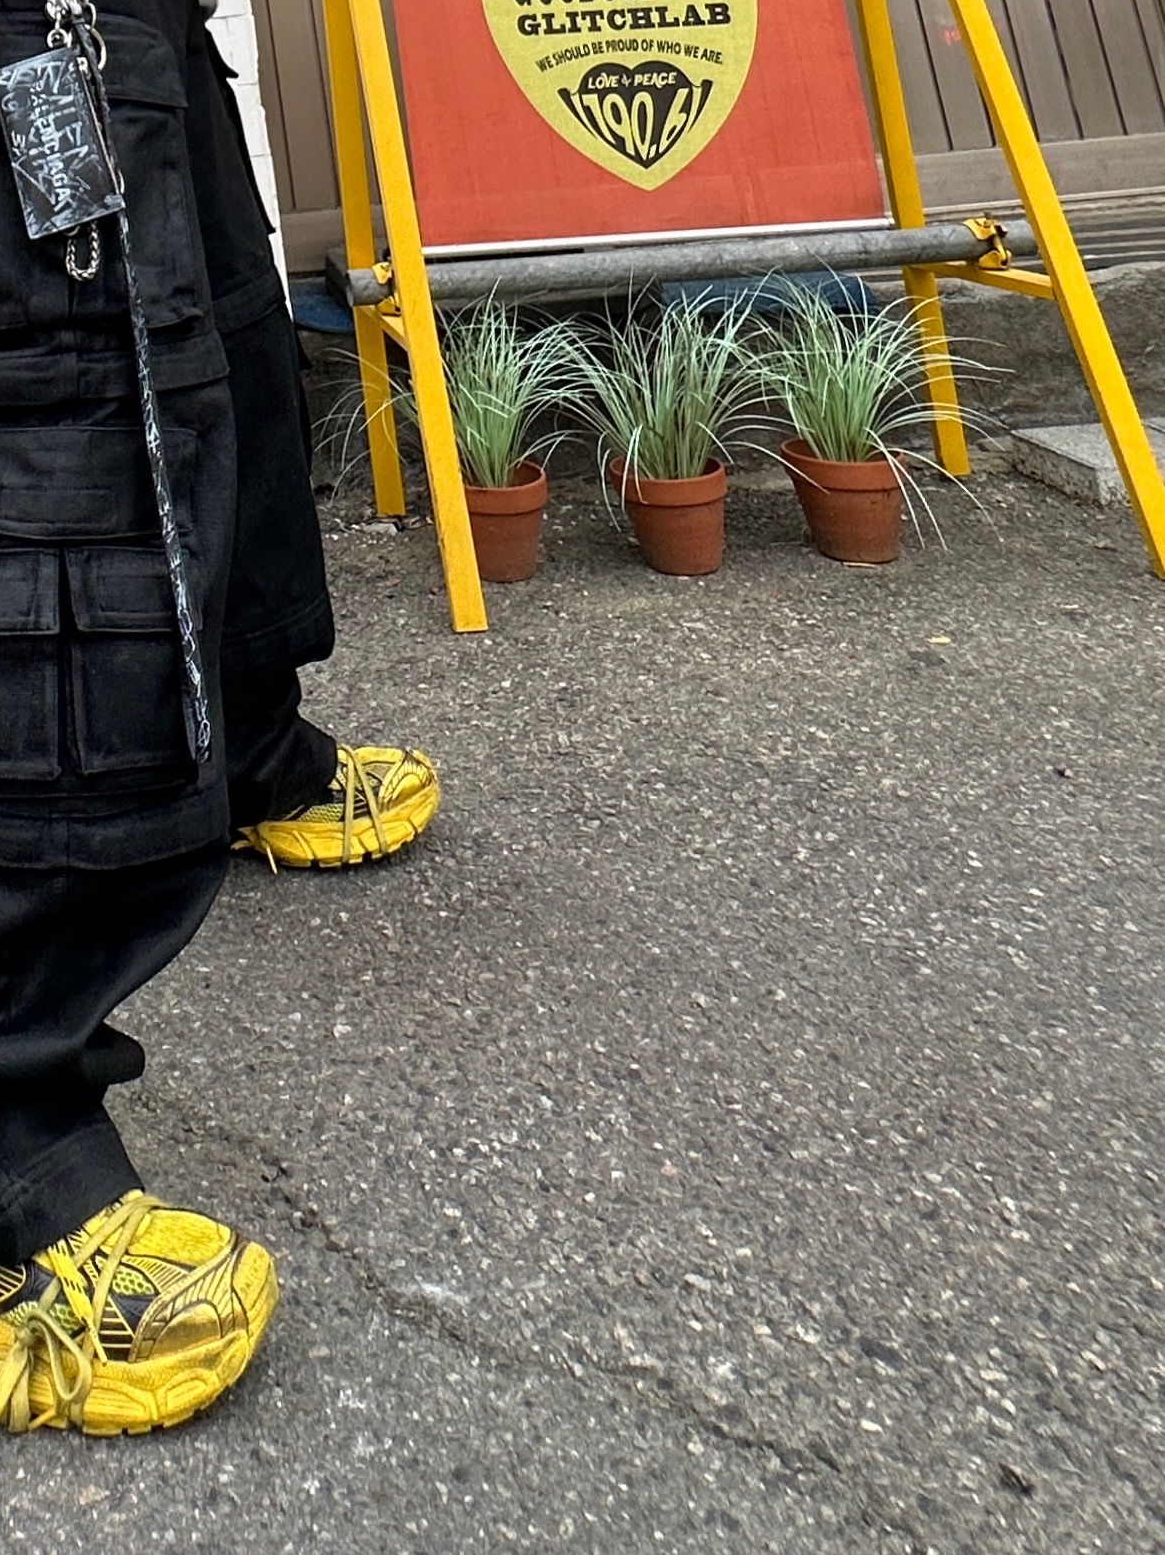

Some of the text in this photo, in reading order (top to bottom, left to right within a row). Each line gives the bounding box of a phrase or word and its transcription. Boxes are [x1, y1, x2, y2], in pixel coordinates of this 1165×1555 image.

[517, 2, 732, 36] GLITCHLAB
[536, 56, 555, 72] WE
[554, 43, 591, 66] SHOULD
[591, 40, 605, 55] BE
[605, 38, 640, 53] PROUD
[640, 38, 655, 53] OF
[655, 39, 682, 55] WHO
[683, 44, 699, 59] WE
[587, 71, 620, 89] LOVE
[633, 72, 678, 89] PEACE
